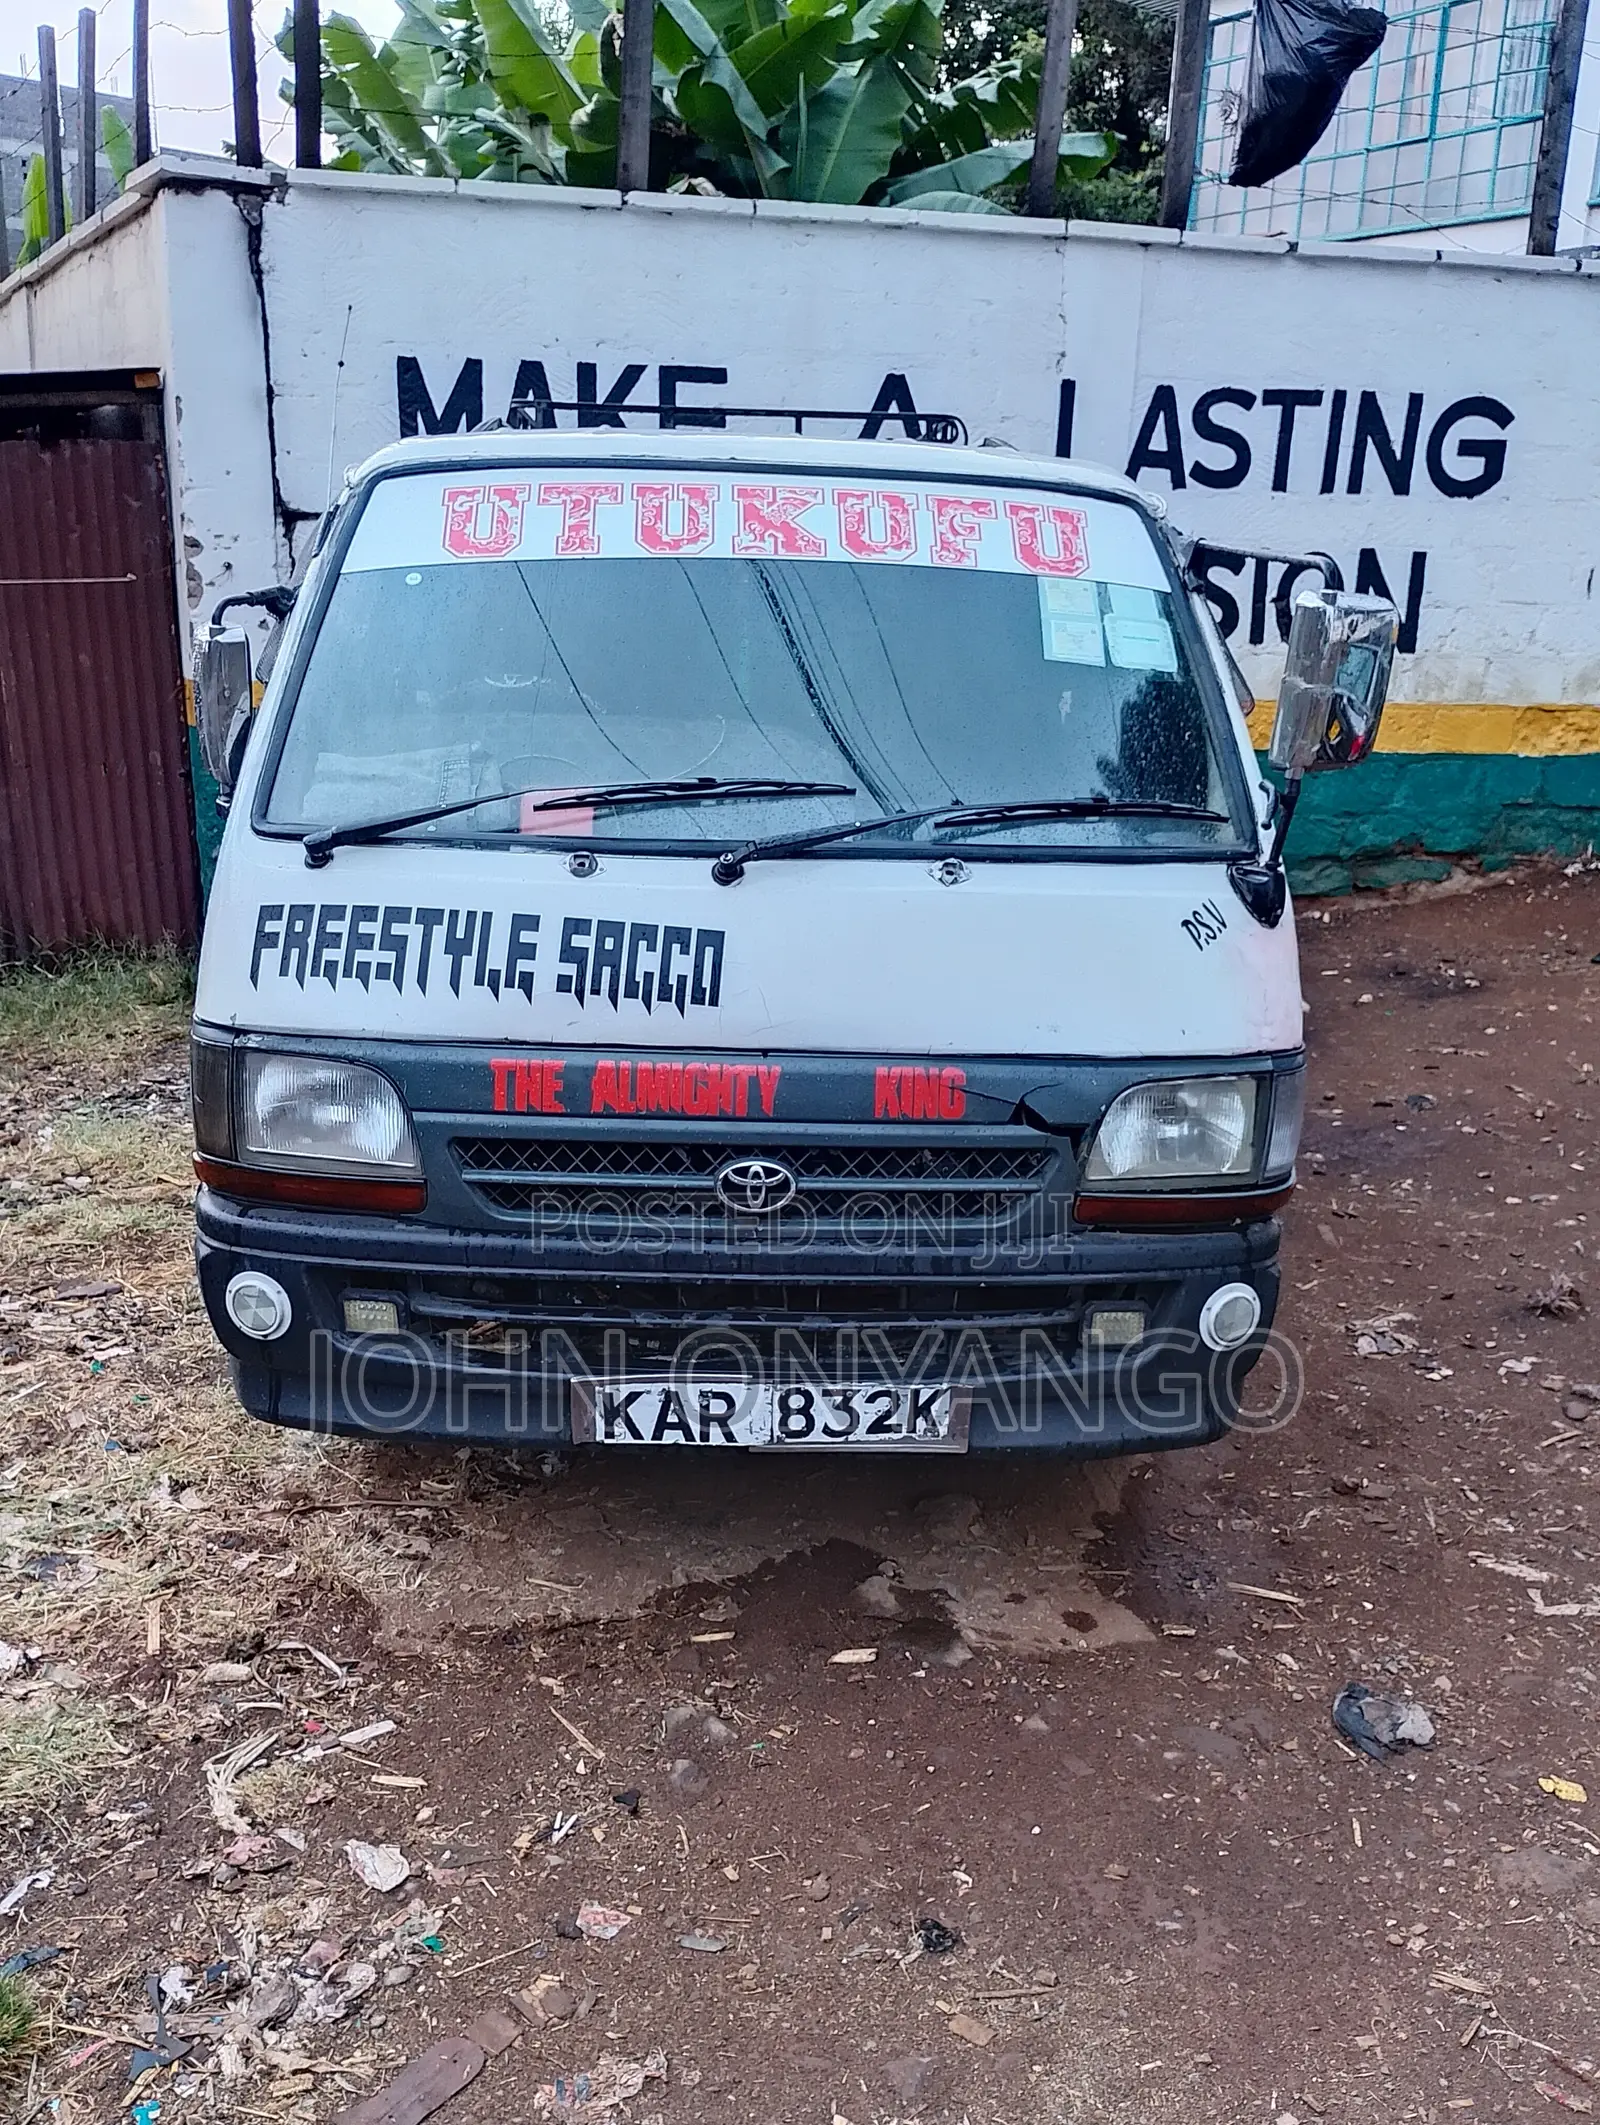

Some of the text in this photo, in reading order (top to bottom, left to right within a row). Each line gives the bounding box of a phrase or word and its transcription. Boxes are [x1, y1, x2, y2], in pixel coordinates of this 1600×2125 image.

[397, 355, 728, 439] MAKE
[857, 373, 922, 440] A
[441, 483, 1090, 577] UTUKUFU
[1194, 546, 1427, 654] SION
[249, 903, 726, 1019] FREESTYLE SACCO
[490, 1058, 967, 1119] THE ALMIGHTY KING
[604, 1387, 950, 1443] KAR 832K
